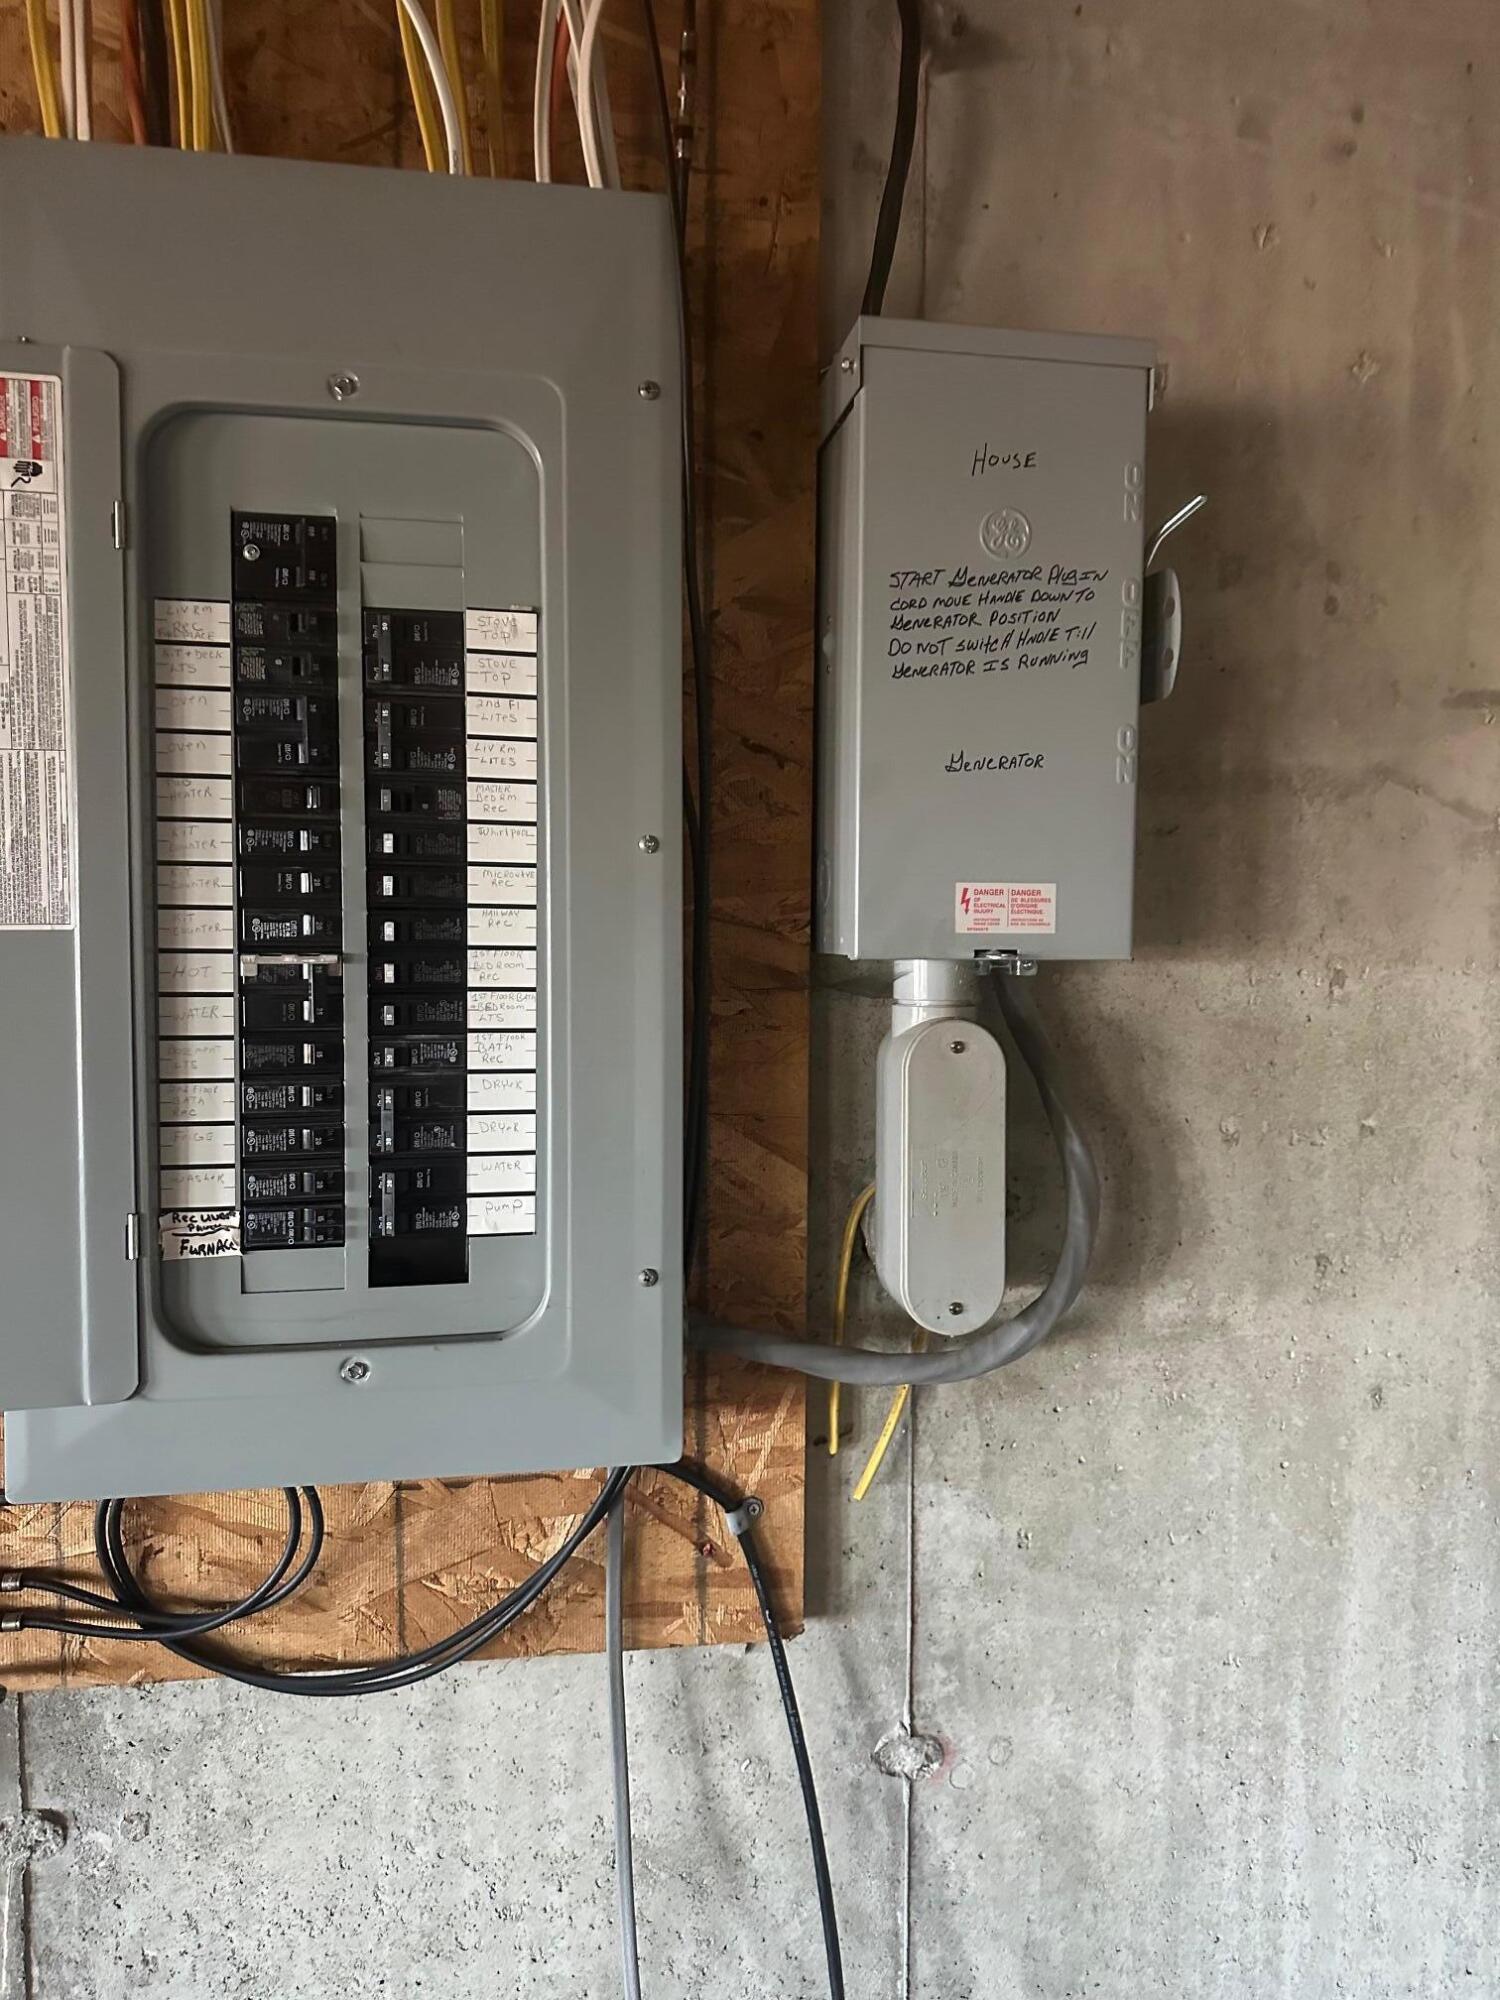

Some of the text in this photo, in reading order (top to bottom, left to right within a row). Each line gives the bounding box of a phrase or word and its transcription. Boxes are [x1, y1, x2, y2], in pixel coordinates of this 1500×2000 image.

[972, 442, 1037, 476] HOUSE
[889, 569, 945, 590] START
[890, 596, 927, 611] CORD
[932, 593, 972, 608] MOVE
[1031, 588, 1074, 603] DOWN
[1075, 587, 1095, 603] TO
[887, 638, 912, 657] DO
[916, 636, 953, 656] NOT
[478, 658, 517, 669] STOVE
[983, 658, 1010, 673] IS
[480, 671, 511, 687] TOP
[172, 965, 212, 978] HOT
